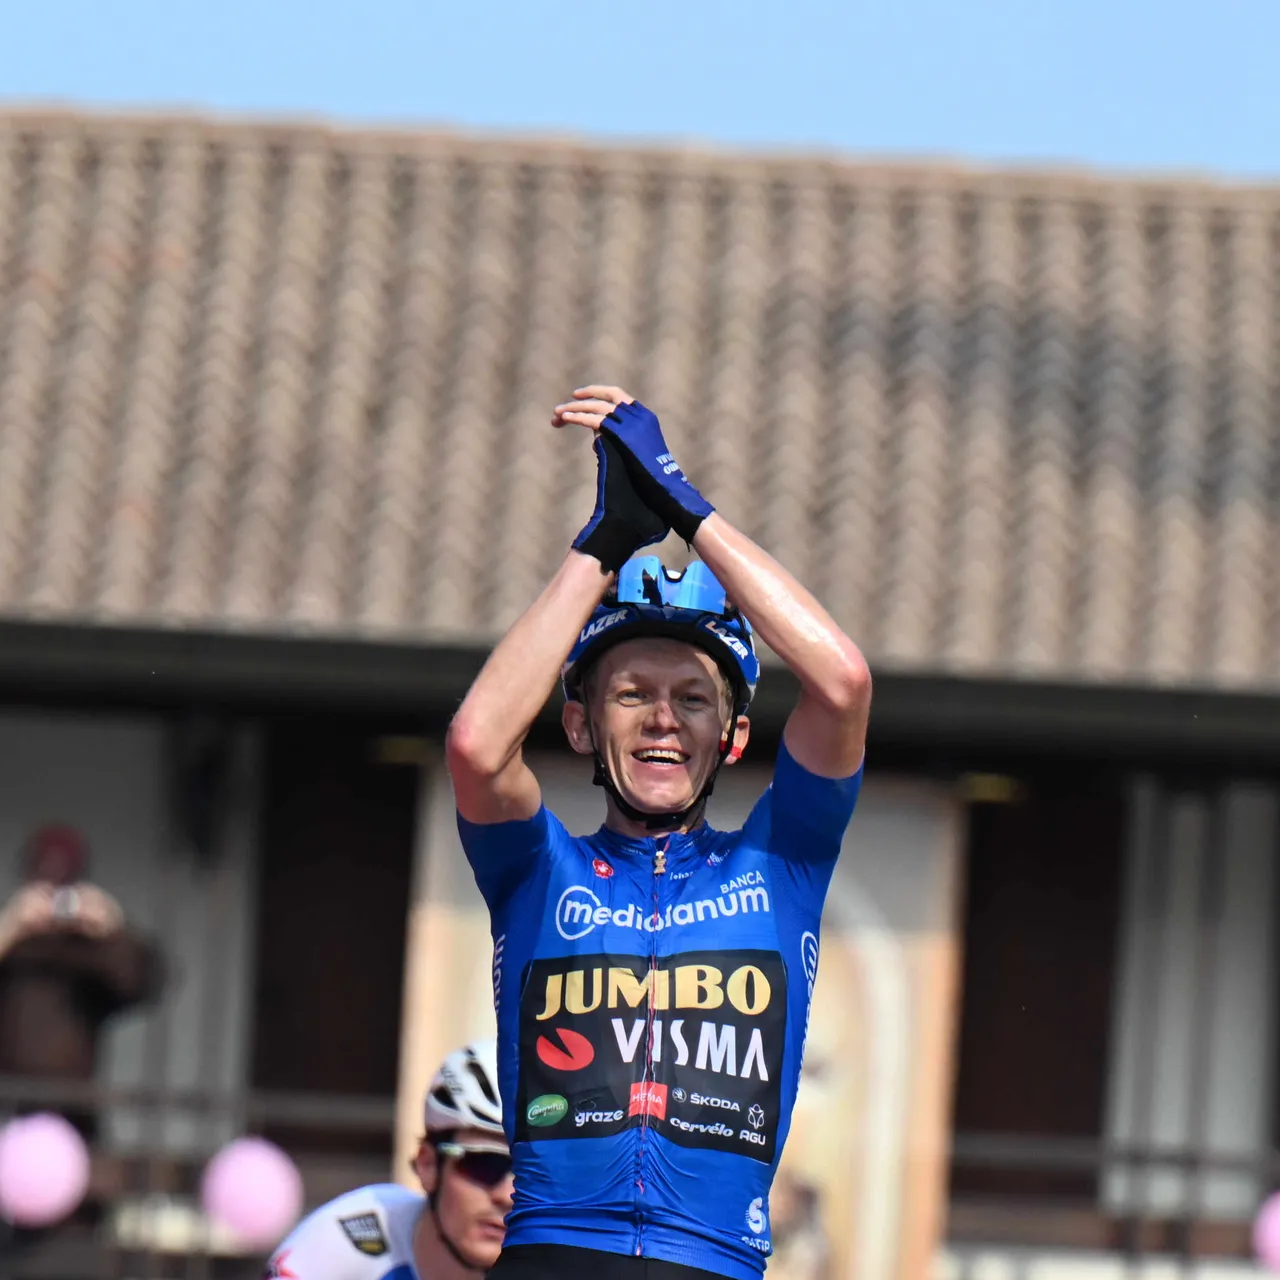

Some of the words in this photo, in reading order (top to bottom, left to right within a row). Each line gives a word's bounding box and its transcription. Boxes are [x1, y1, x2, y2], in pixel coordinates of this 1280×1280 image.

[580, 609, 629, 644] LAZER
[704, 620, 749, 661] LAZER
[720, 869, 765, 895] BANCA
[535, 964, 772, 1021] JUMBO
[610, 1018, 770, 1083] VISMA
[631, 1092, 663, 1105] HEMA
[690, 1092, 741, 1112] ŠKODA
[574, 1110, 624, 1127] graze
[669, 1117, 734, 1137] cervélo
[739, 1129, 766, 1146] AGU
